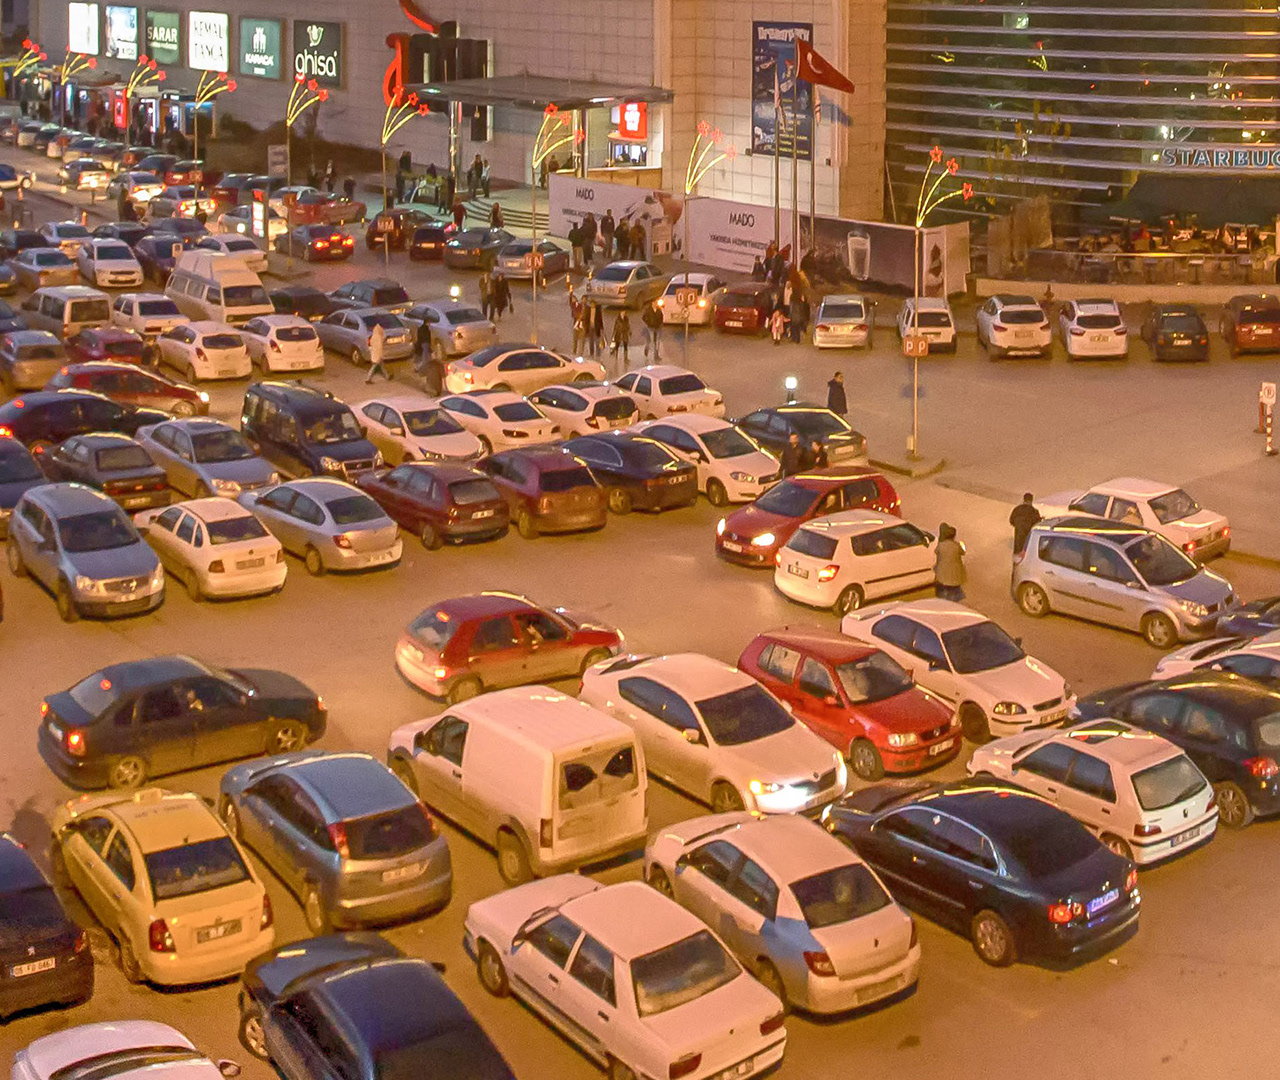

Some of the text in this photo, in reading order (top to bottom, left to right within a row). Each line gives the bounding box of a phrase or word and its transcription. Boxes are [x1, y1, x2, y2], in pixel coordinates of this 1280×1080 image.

[147, 26, 178, 43] SARAR
[576, 188, 594, 201] MADO
[729, 212, 755, 227] MADO
